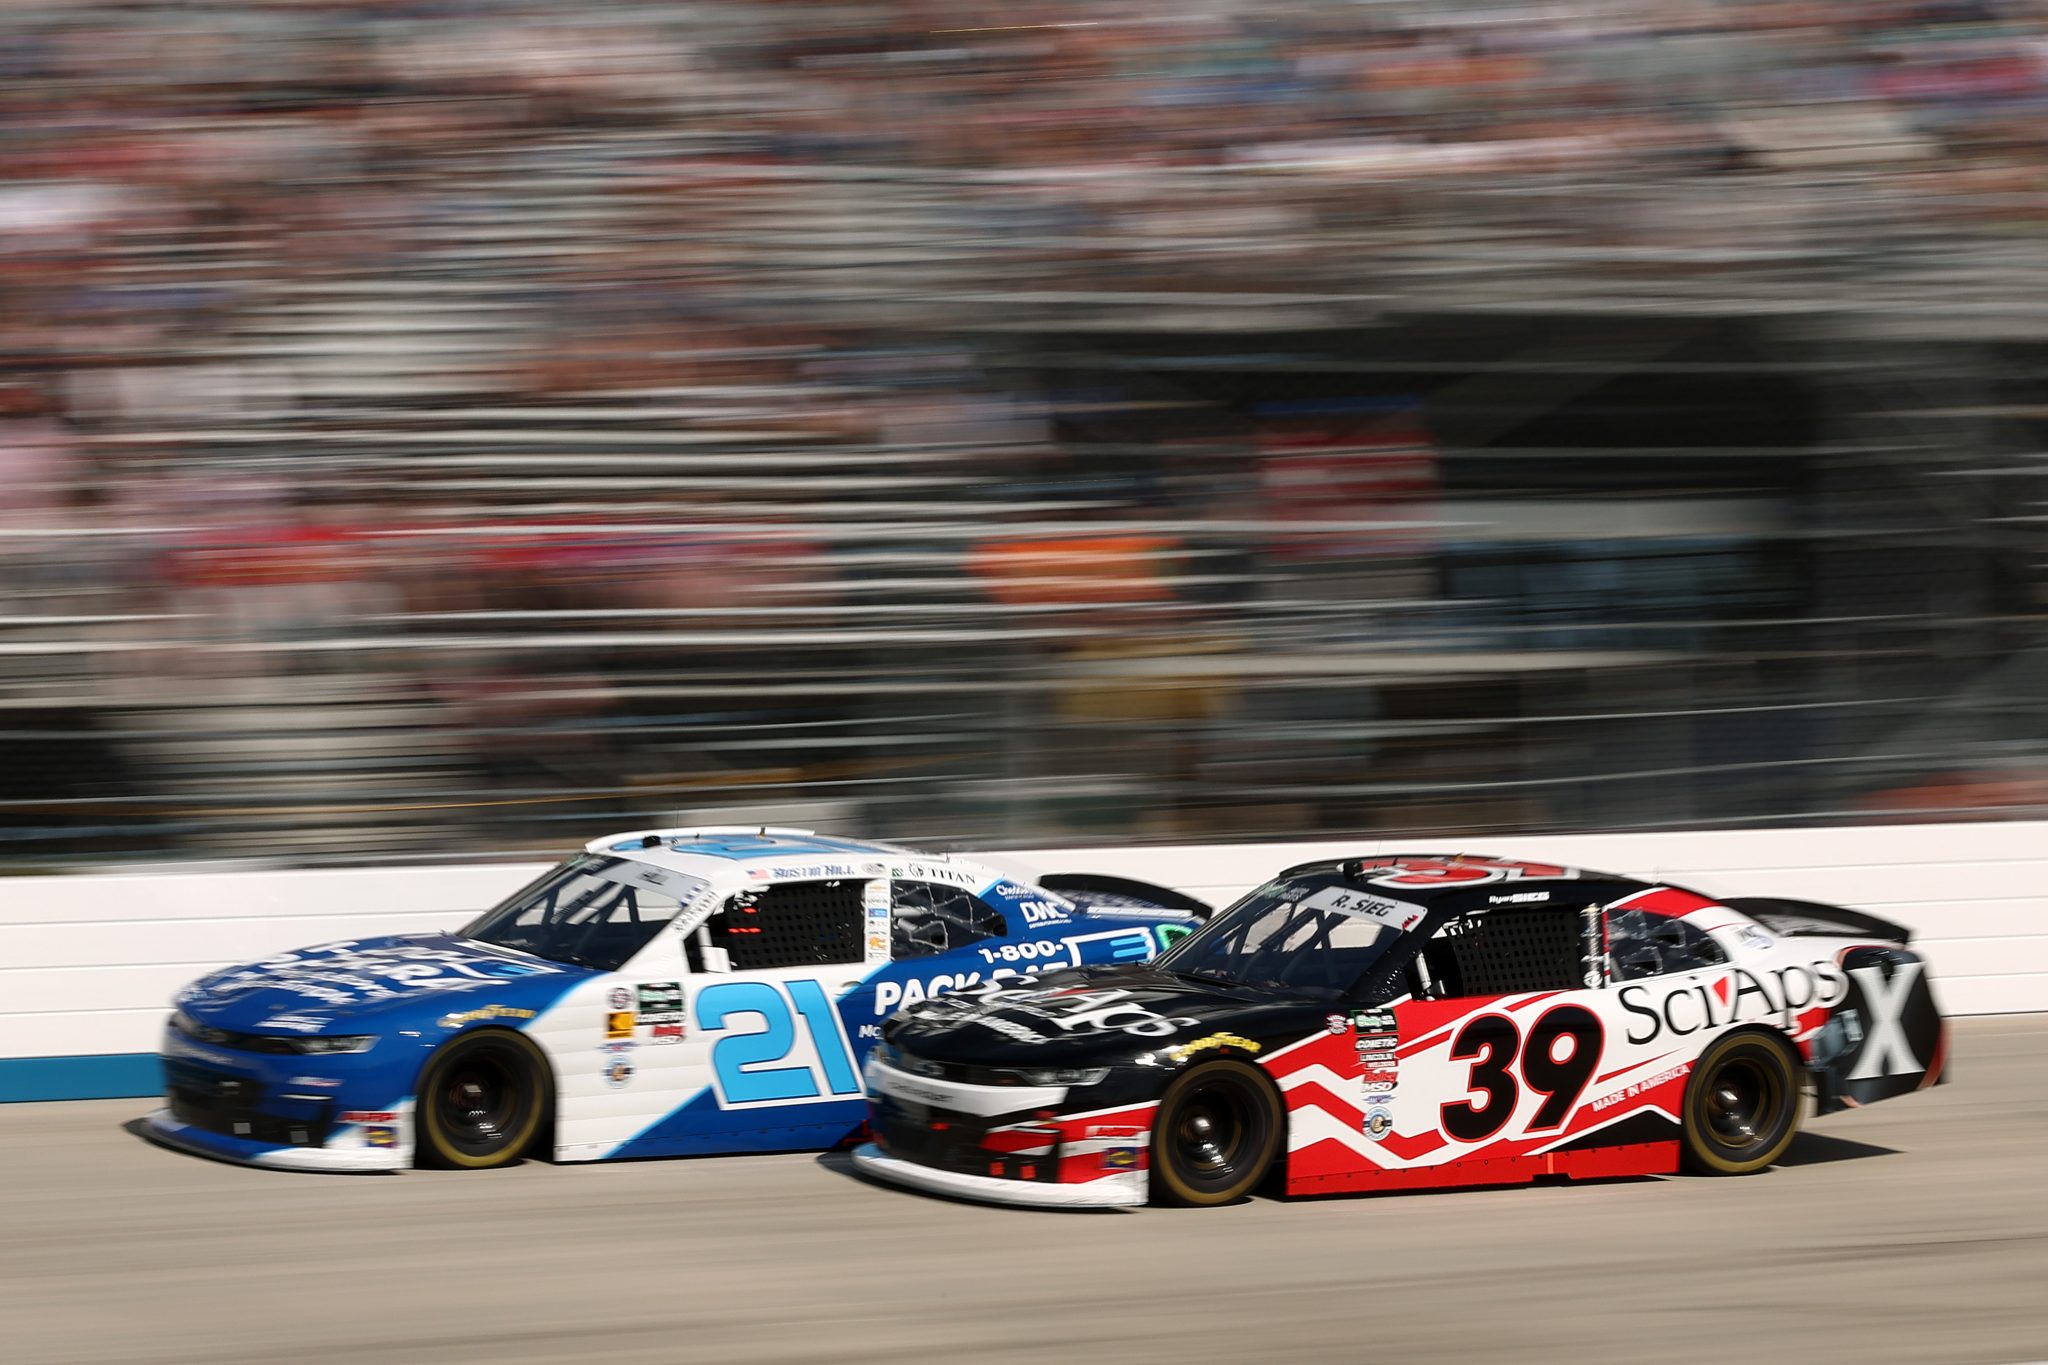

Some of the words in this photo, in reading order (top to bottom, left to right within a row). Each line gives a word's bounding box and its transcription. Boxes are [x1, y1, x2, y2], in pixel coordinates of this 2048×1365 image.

[931, 868, 977, 885] TITAN
[1350, 899, 1396, 918] SIEG
[1019, 902, 1068, 923] DWC
[1618, 960, 1849, 1045] SciAps
[1846, 962, 1927, 1080] X
[697, 979, 861, 1104] 21
[1441, 1003, 1605, 1143] 39
[1593, 1091, 1626, 1112] MADE
[1628, 1084, 1640, 1097] IN
[1641, 1063, 1690, 1091] AMERICA
